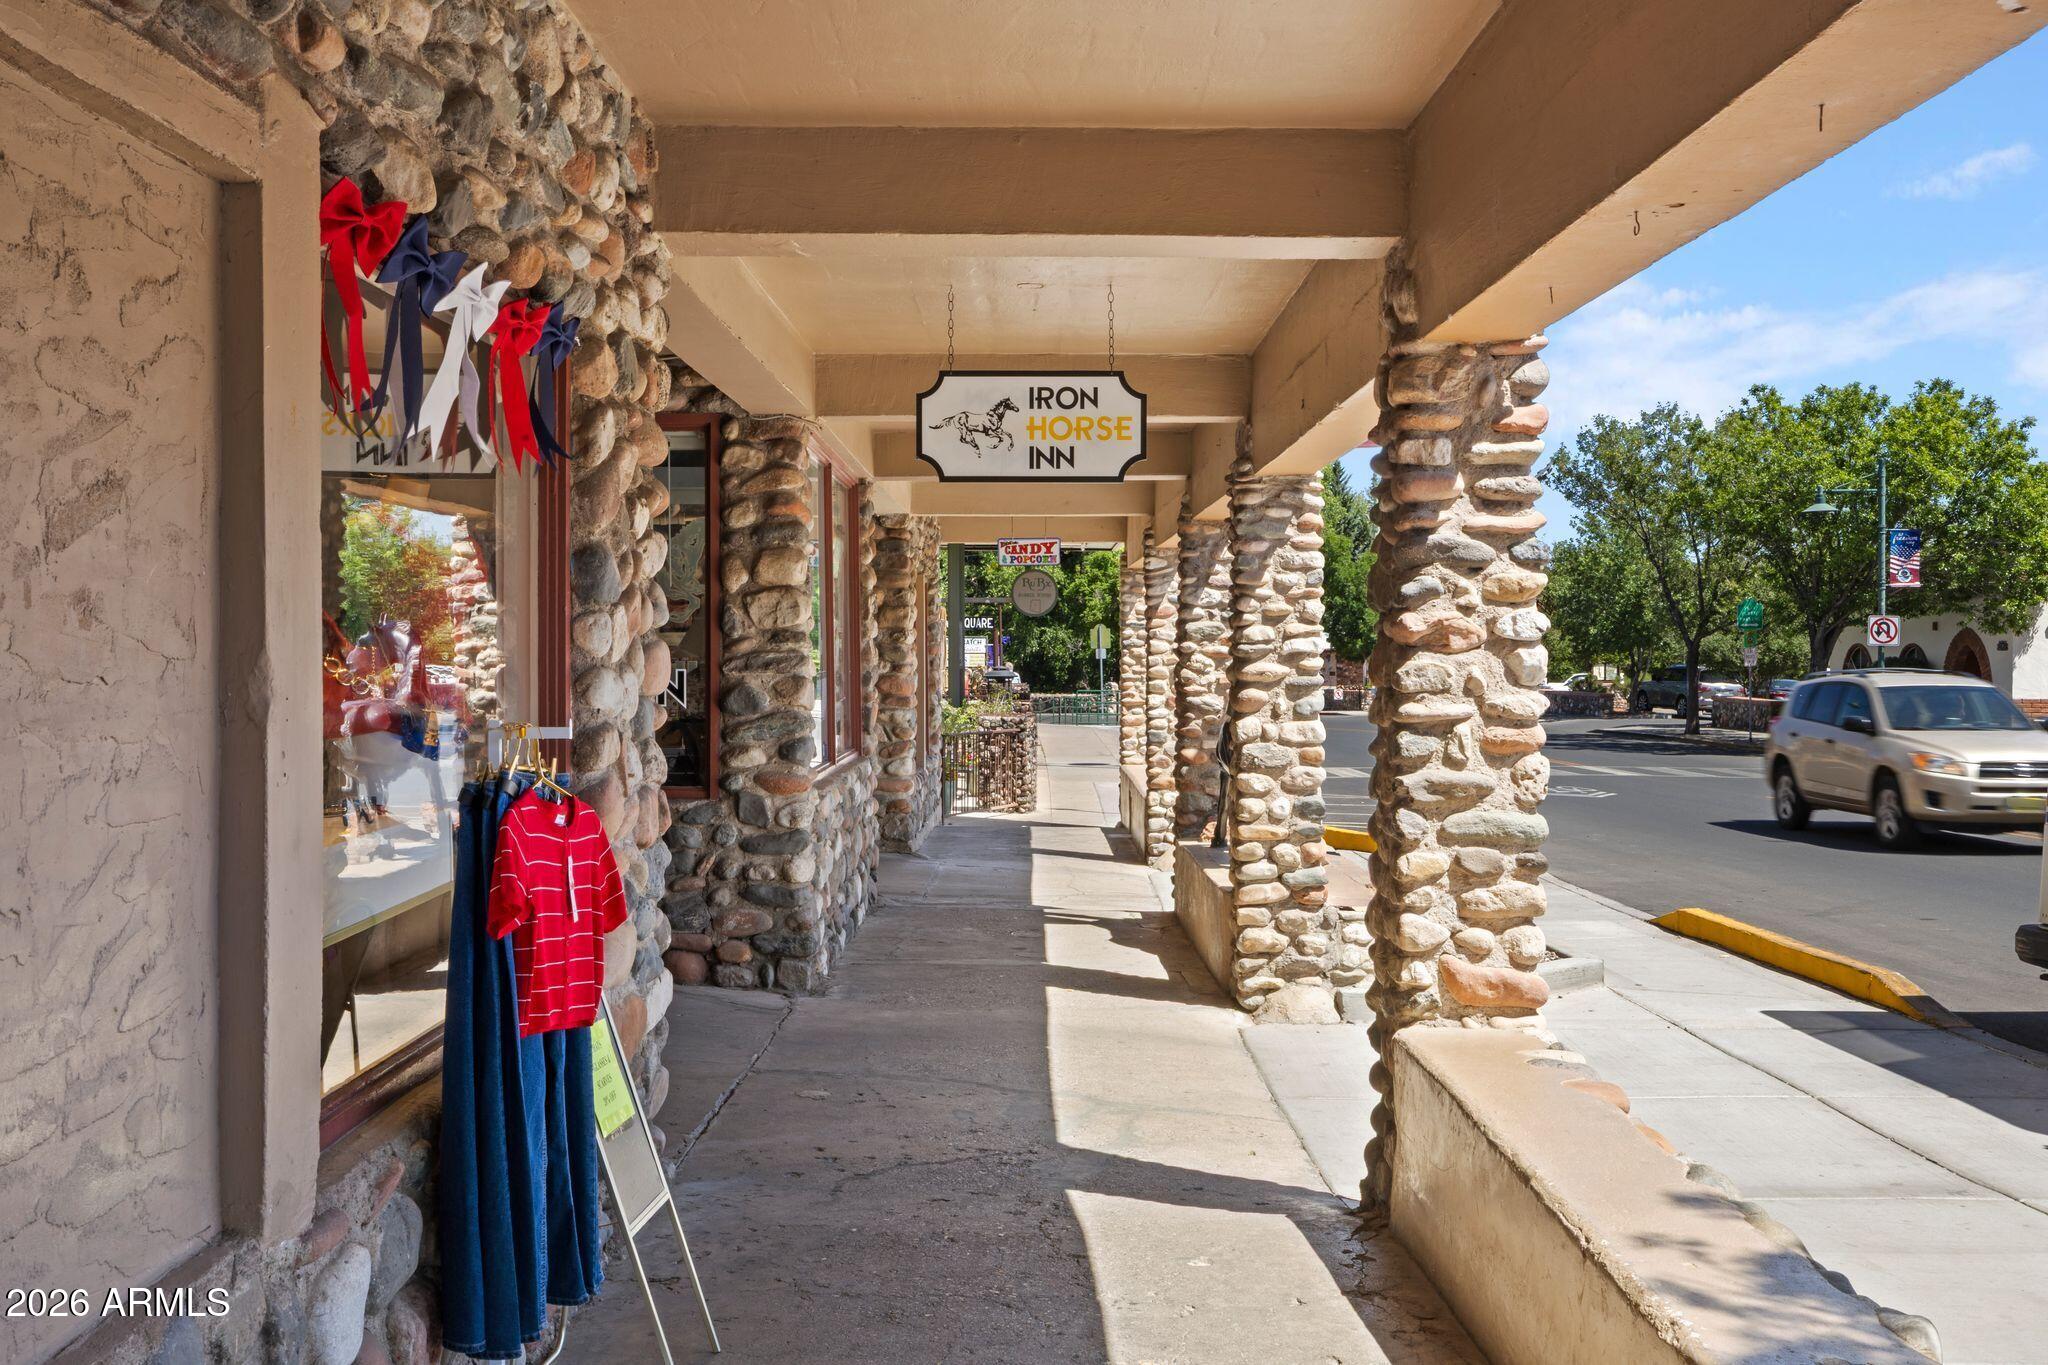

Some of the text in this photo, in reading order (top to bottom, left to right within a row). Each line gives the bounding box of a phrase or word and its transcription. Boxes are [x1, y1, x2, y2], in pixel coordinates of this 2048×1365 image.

[1029, 386, 1099, 410] IRON
[1026, 416, 1133, 441] HORSE
[1029, 446, 1075, 470] INN
[1005, 542, 1057, 554] CANDY
[1010, 555, 1057, 563] POPCORN
[964, 617, 993, 628] QUARE
